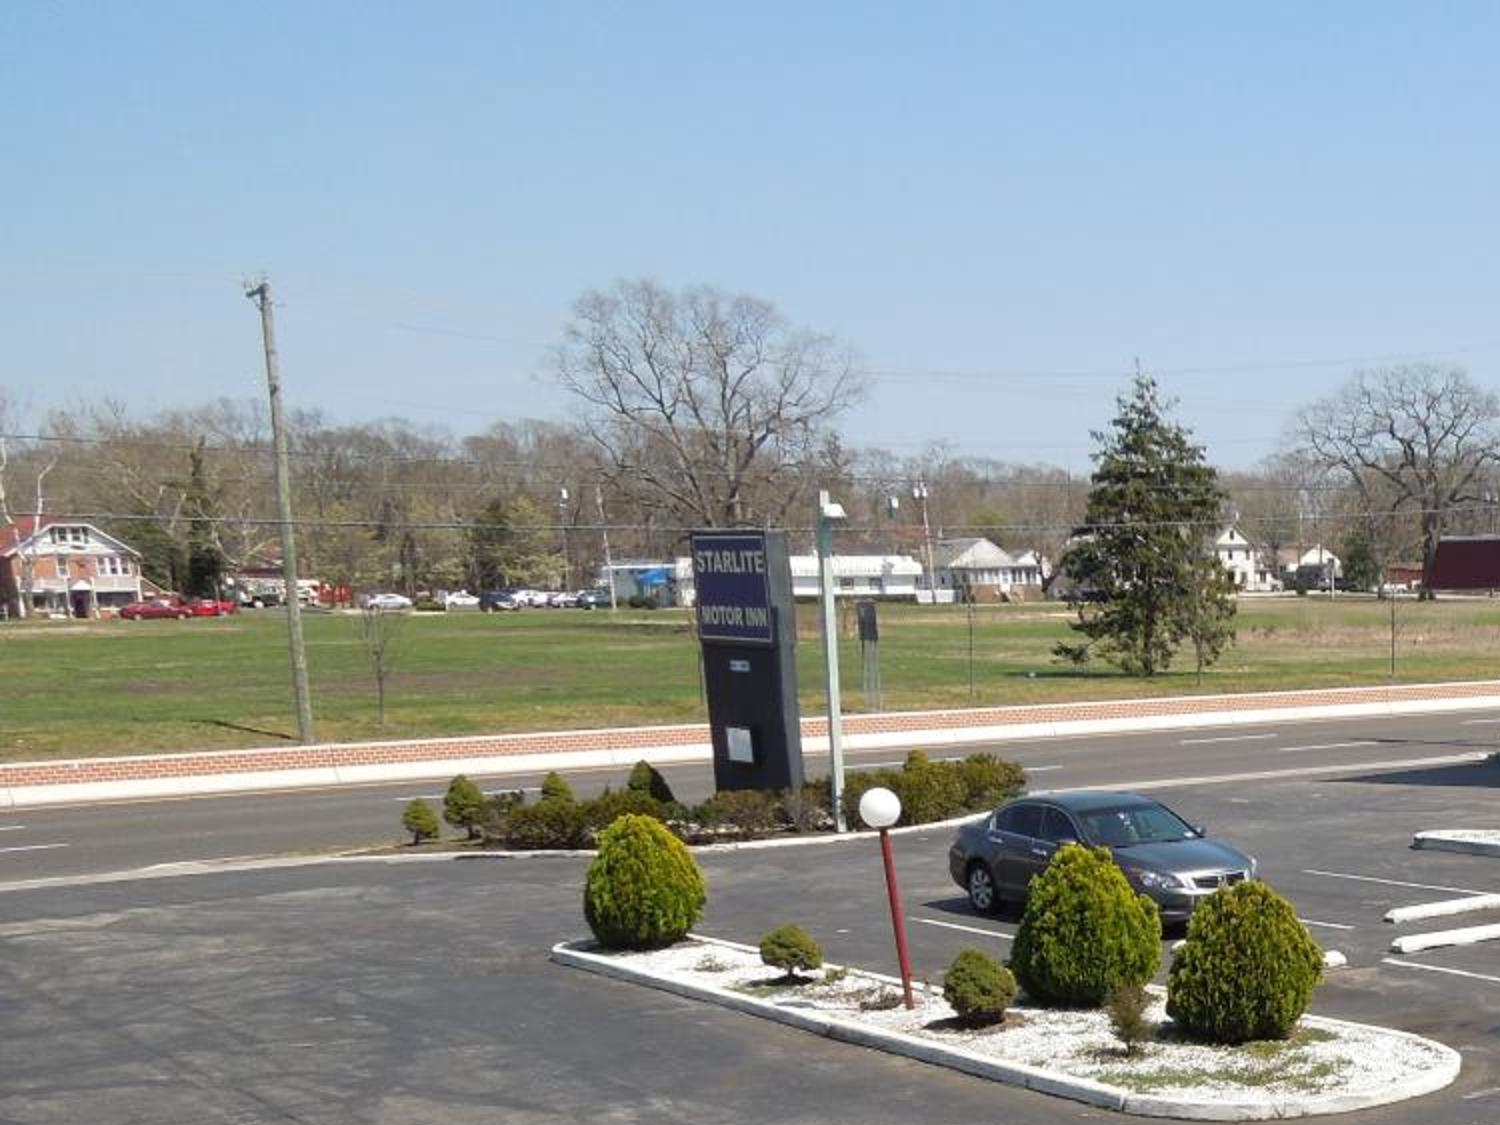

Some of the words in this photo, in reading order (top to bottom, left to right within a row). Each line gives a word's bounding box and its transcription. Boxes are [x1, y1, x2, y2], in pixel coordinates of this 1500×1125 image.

[697, 551, 765, 573] STARLITE
[702, 606, 743, 625] MOTOR
[745, 607, 768, 627] INN
